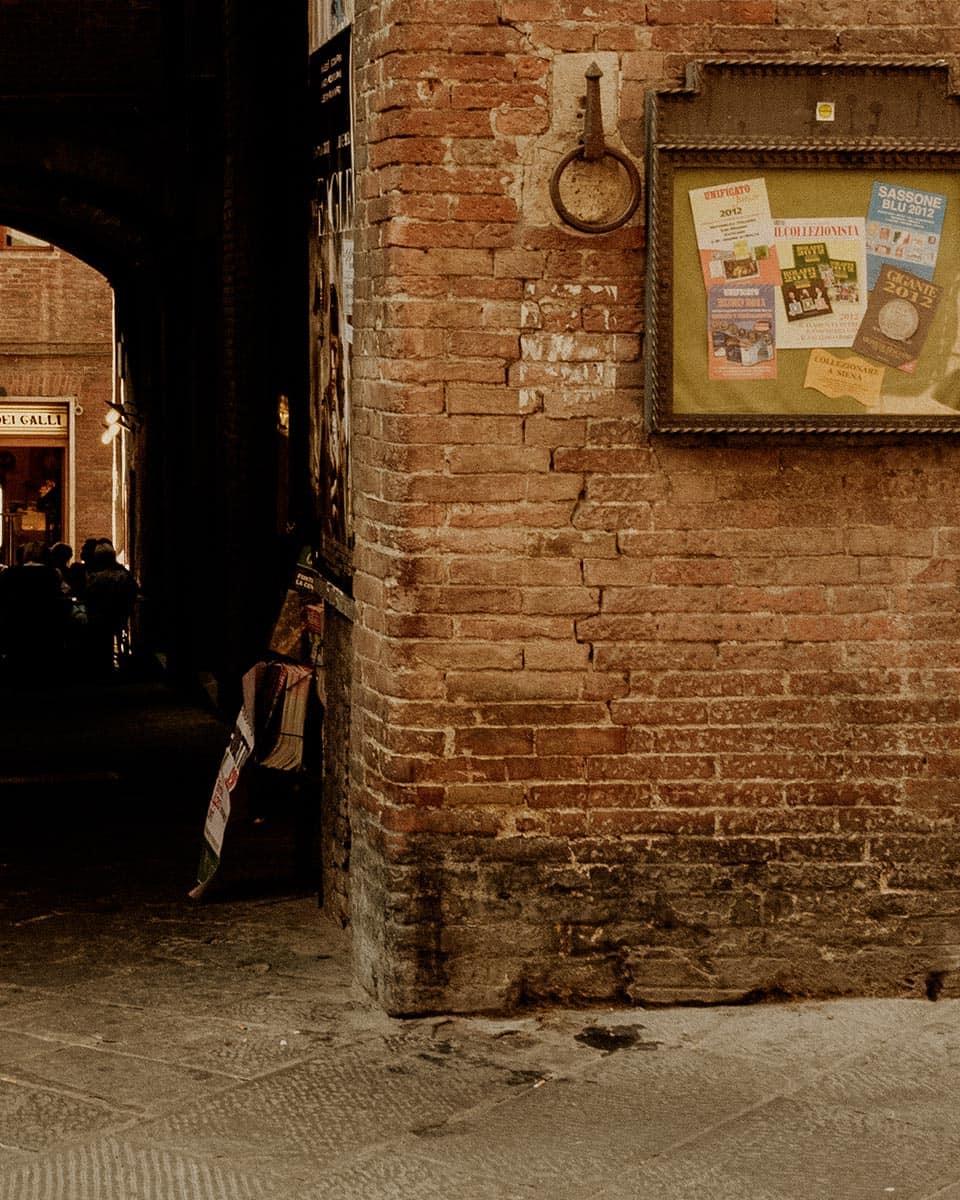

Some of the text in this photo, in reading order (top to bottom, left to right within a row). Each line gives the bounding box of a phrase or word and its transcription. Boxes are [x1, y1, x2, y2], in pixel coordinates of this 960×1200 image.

[704, 185, 751, 200] UNIFICATO
[878, 186, 942, 209] SASSONE
[720, 207, 742, 218] 2012
[881, 198, 935, 218] BLU 2012
[887, 270, 938, 298] GIGANTE
[883, 281, 933, 309] 2012
[19, 414, 62, 426] GALLI
